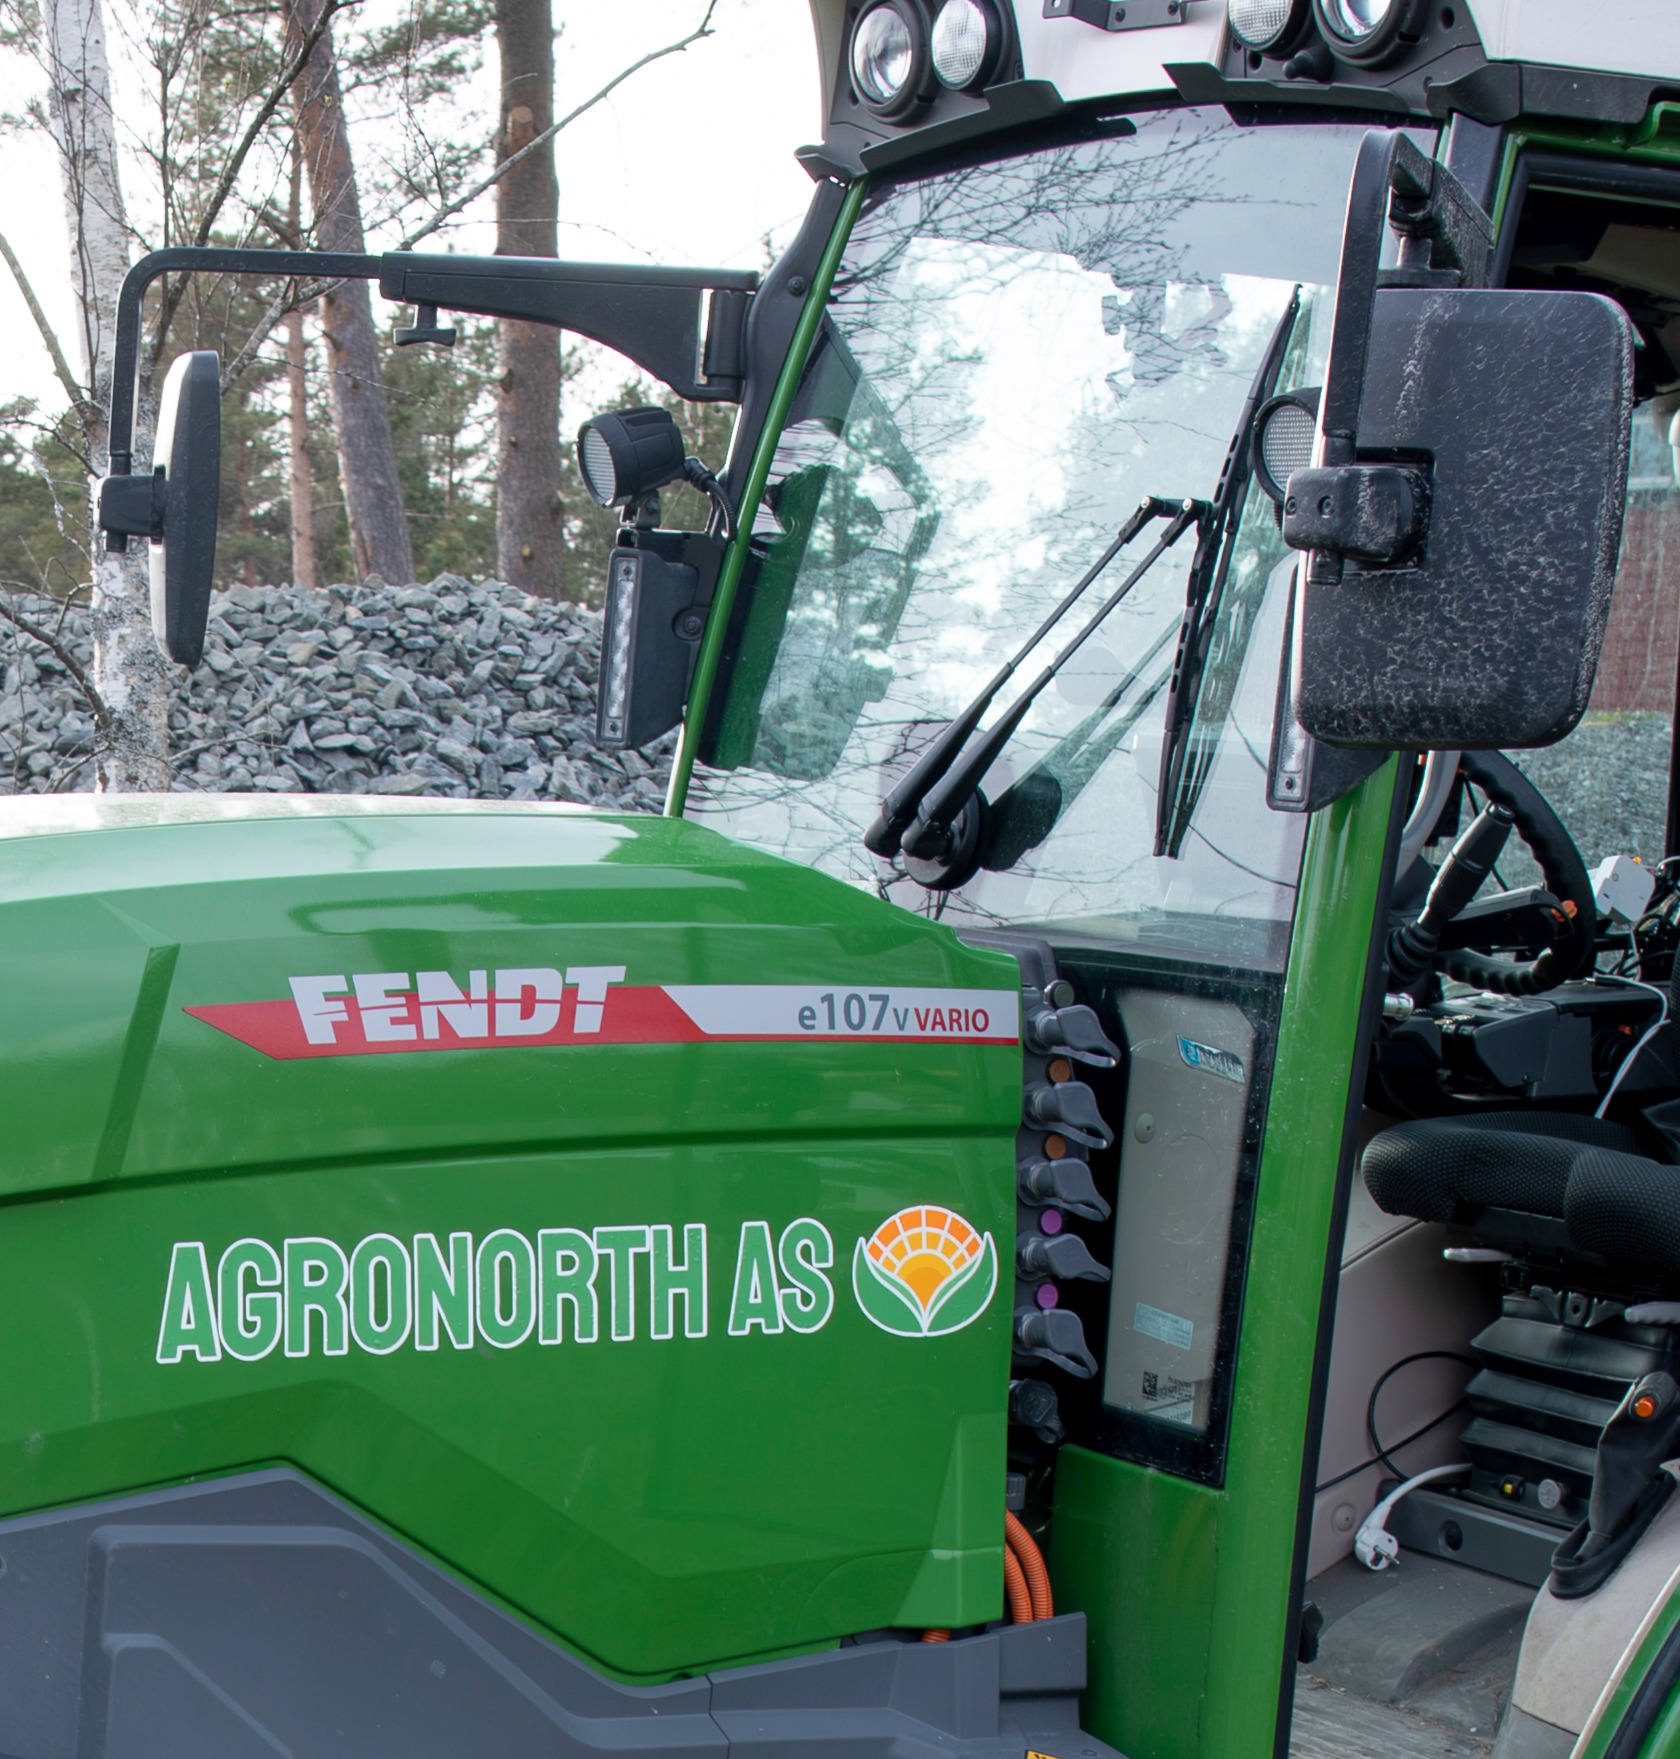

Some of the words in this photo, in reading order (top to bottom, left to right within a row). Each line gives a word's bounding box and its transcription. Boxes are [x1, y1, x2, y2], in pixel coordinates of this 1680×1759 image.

[288, 965, 627, 1046] FENDT
[914, 1007, 990, 1033] VARIO
[155, 1223, 708, 1364] AGRONORTH
[728, 1217, 835, 1337] AS
